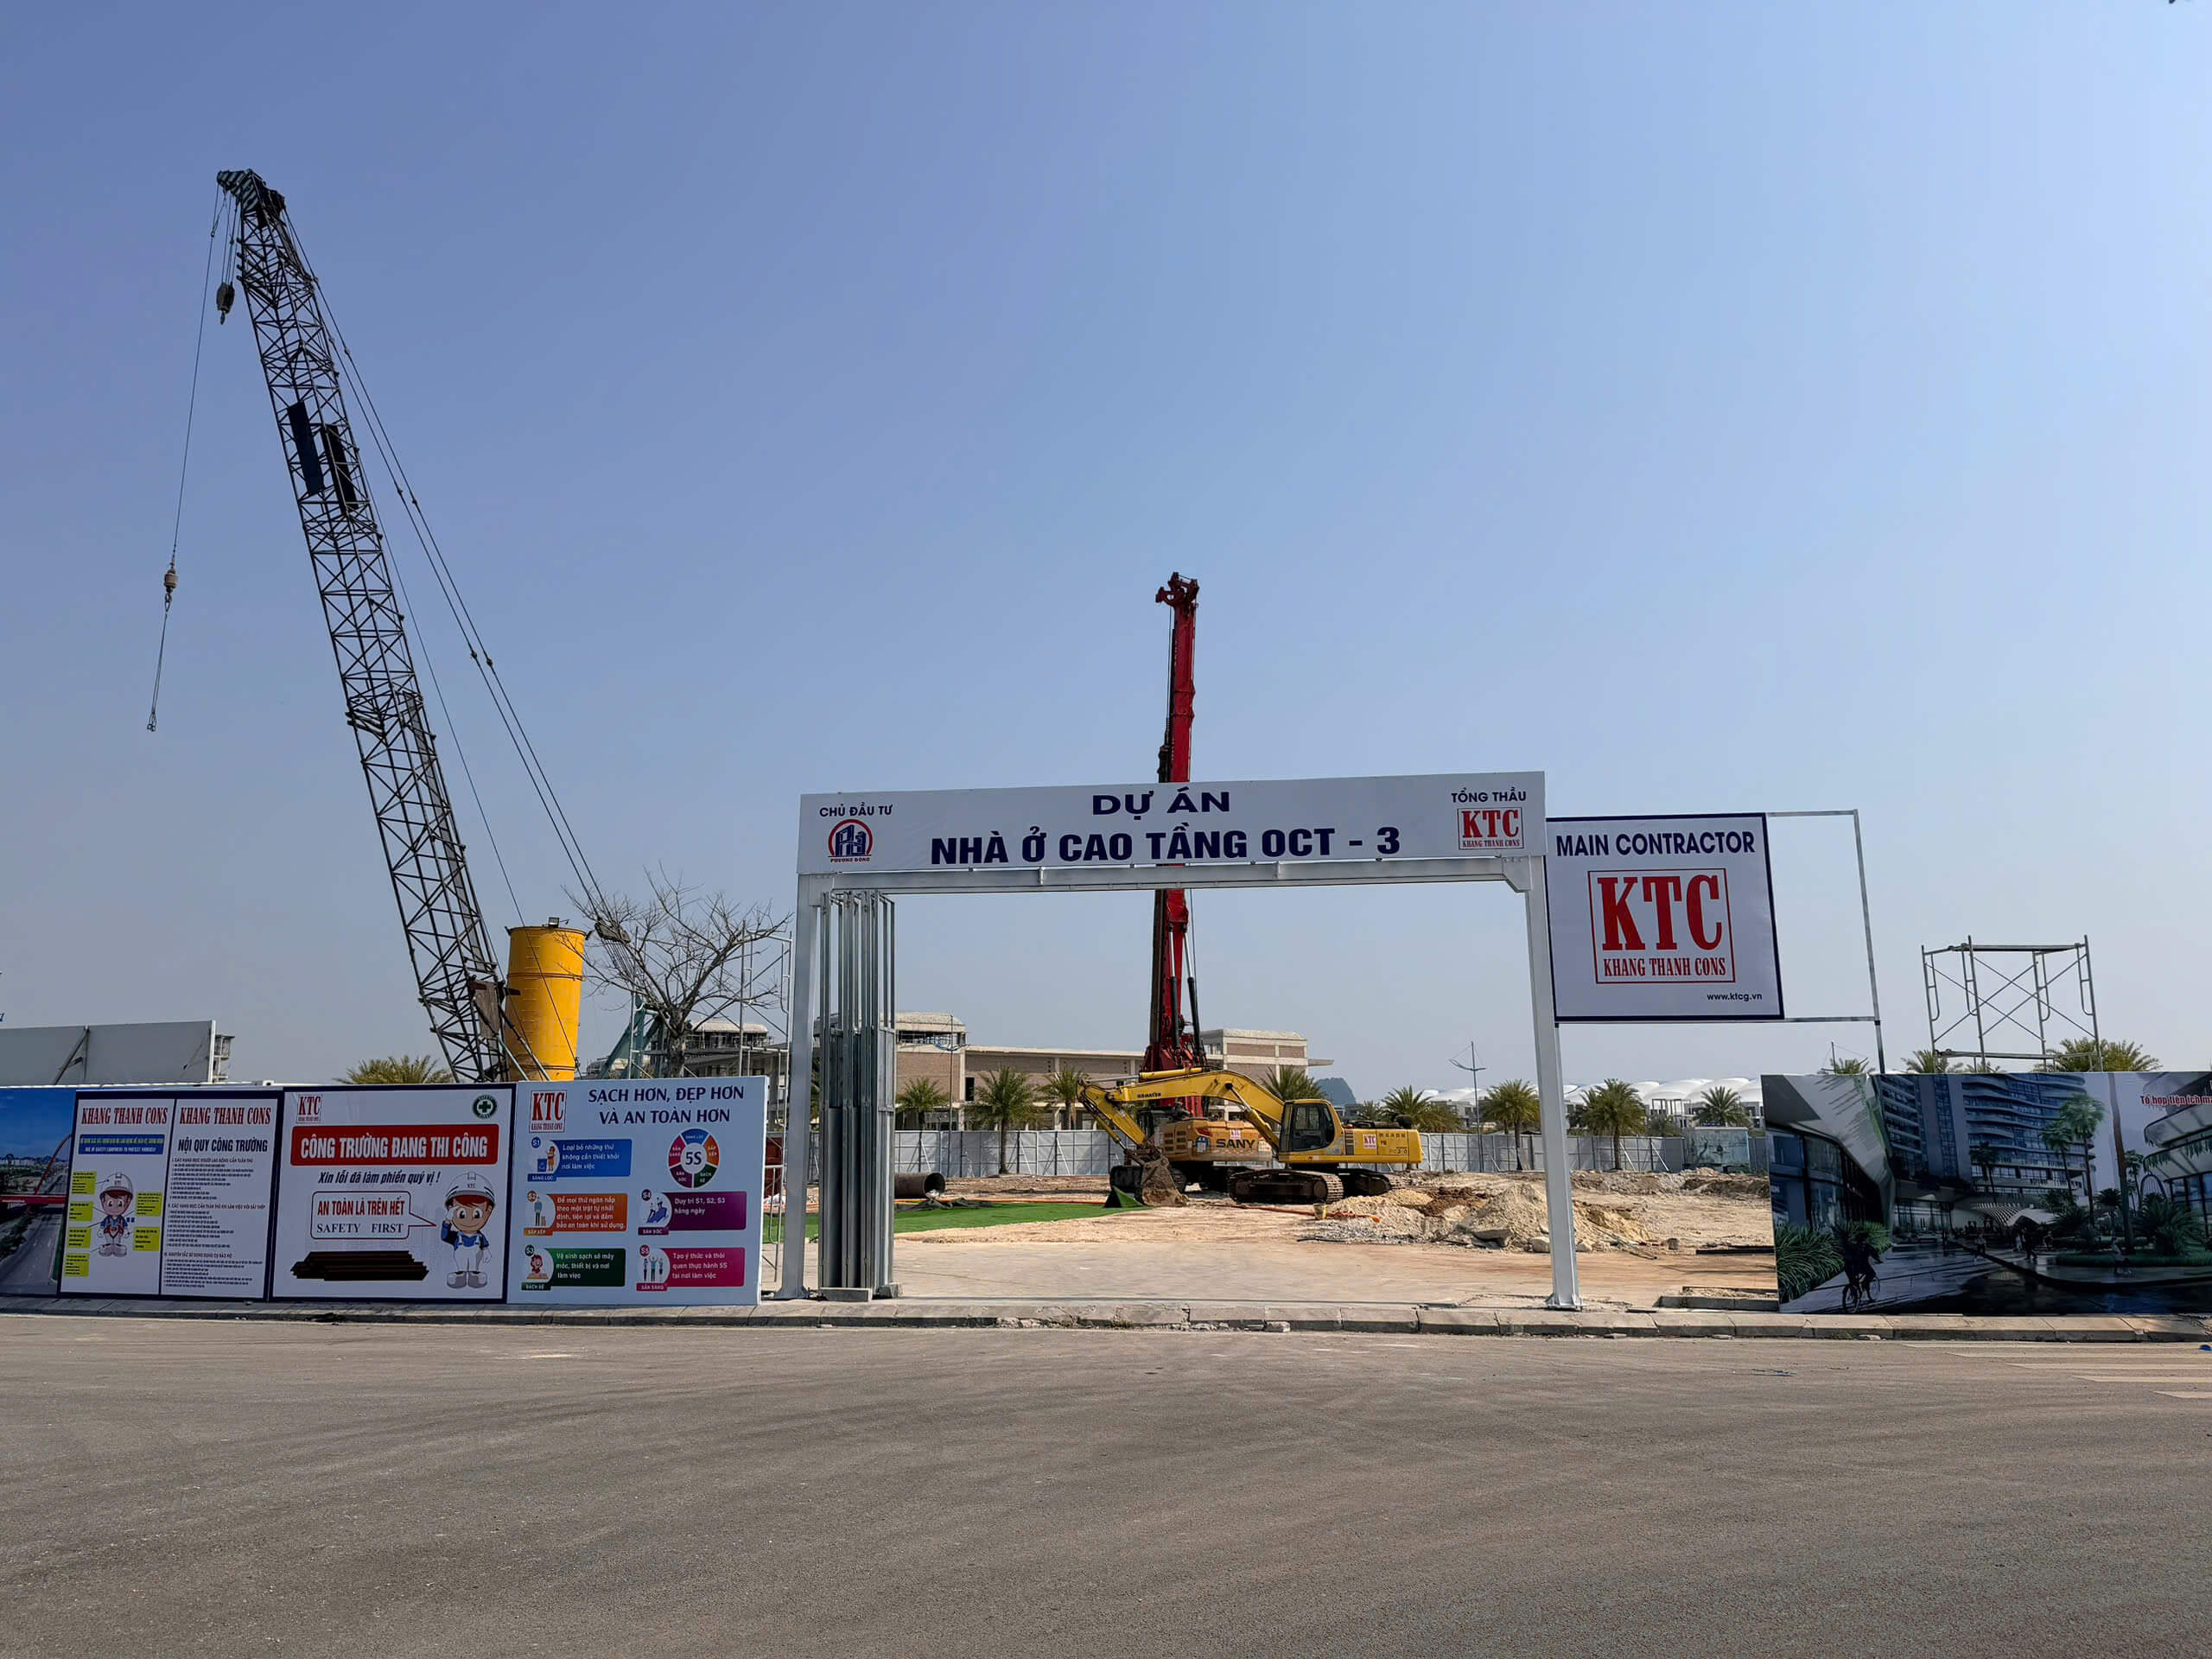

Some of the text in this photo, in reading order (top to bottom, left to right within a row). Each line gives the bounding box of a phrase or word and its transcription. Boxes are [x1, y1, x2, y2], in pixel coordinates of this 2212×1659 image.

[1092, 786, 1230, 820] DỰ ÁN
[1452, 786, 1526, 803] TỔNG THẦU
[819, 801, 893, 817] CHỦ ĐẦU TƯ
[1461, 809, 1520, 838] KTC
[931, 831, 1009, 864] NHÀ
[1021, 825, 1046, 863] Ở
[1058, 833, 1133, 861] CAO
[1146, 823, 1247, 860] TẦNG
[1262, 828, 1335, 858] OCT
[1376, 827, 1400, 855] 3
[1462, 838, 1520, 849] KHANG THANH CONS
[1556, 831, 1755, 856] MAIN CONTRACTOR
[1598, 874, 1722, 950] KTC
[1604, 957, 1726, 976] KHANG THANH CONS
[1707, 993, 1763, 1002] www.ktcg.vn
[588, 1085, 744, 1105] SẠCH HƠN, ĐẸP HƠN
[299, 1096, 321, 1116] KTC
[532, 1092, 564, 1121] KTC
[600, 1106, 730, 1124] VÀ AN TOÀN HƠN
[81, 1107, 168, 1124] KHANG THANH CONS
[180, 1107, 271, 1124] KHANG THANH CONS
[178, 1136, 192, 1154] NỘI
[194, 1140, 210, 1153] QUY
[211, 1137, 233, 1152] CÔNG
[236, 1136, 268, 1152] TRƯỜNG
[301, 1131, 488, 1159] CÔNG TRƯỜNG ĐANG THI CÔNG
[1217, 1139, 1255, 1148] SANY
[685, 1151, 702, 1166] 5S
[318, 1172, 334, 1184] Xin
[335, 1169, 349, 1183] lỗi
[349, 1171, 361, 1184] đã
[363, 1171, 379, 1184] làm
[408, 1171, 425, 1185] quý
[427, 1171, 435, 1186] vị
[436, 1171, 441, 1183] !
[318, 1196, 405, 1216] AN TOÀN LÀ TRÊN HẾT
[317, 1223, 404, 1233] SAFETY FIRST
